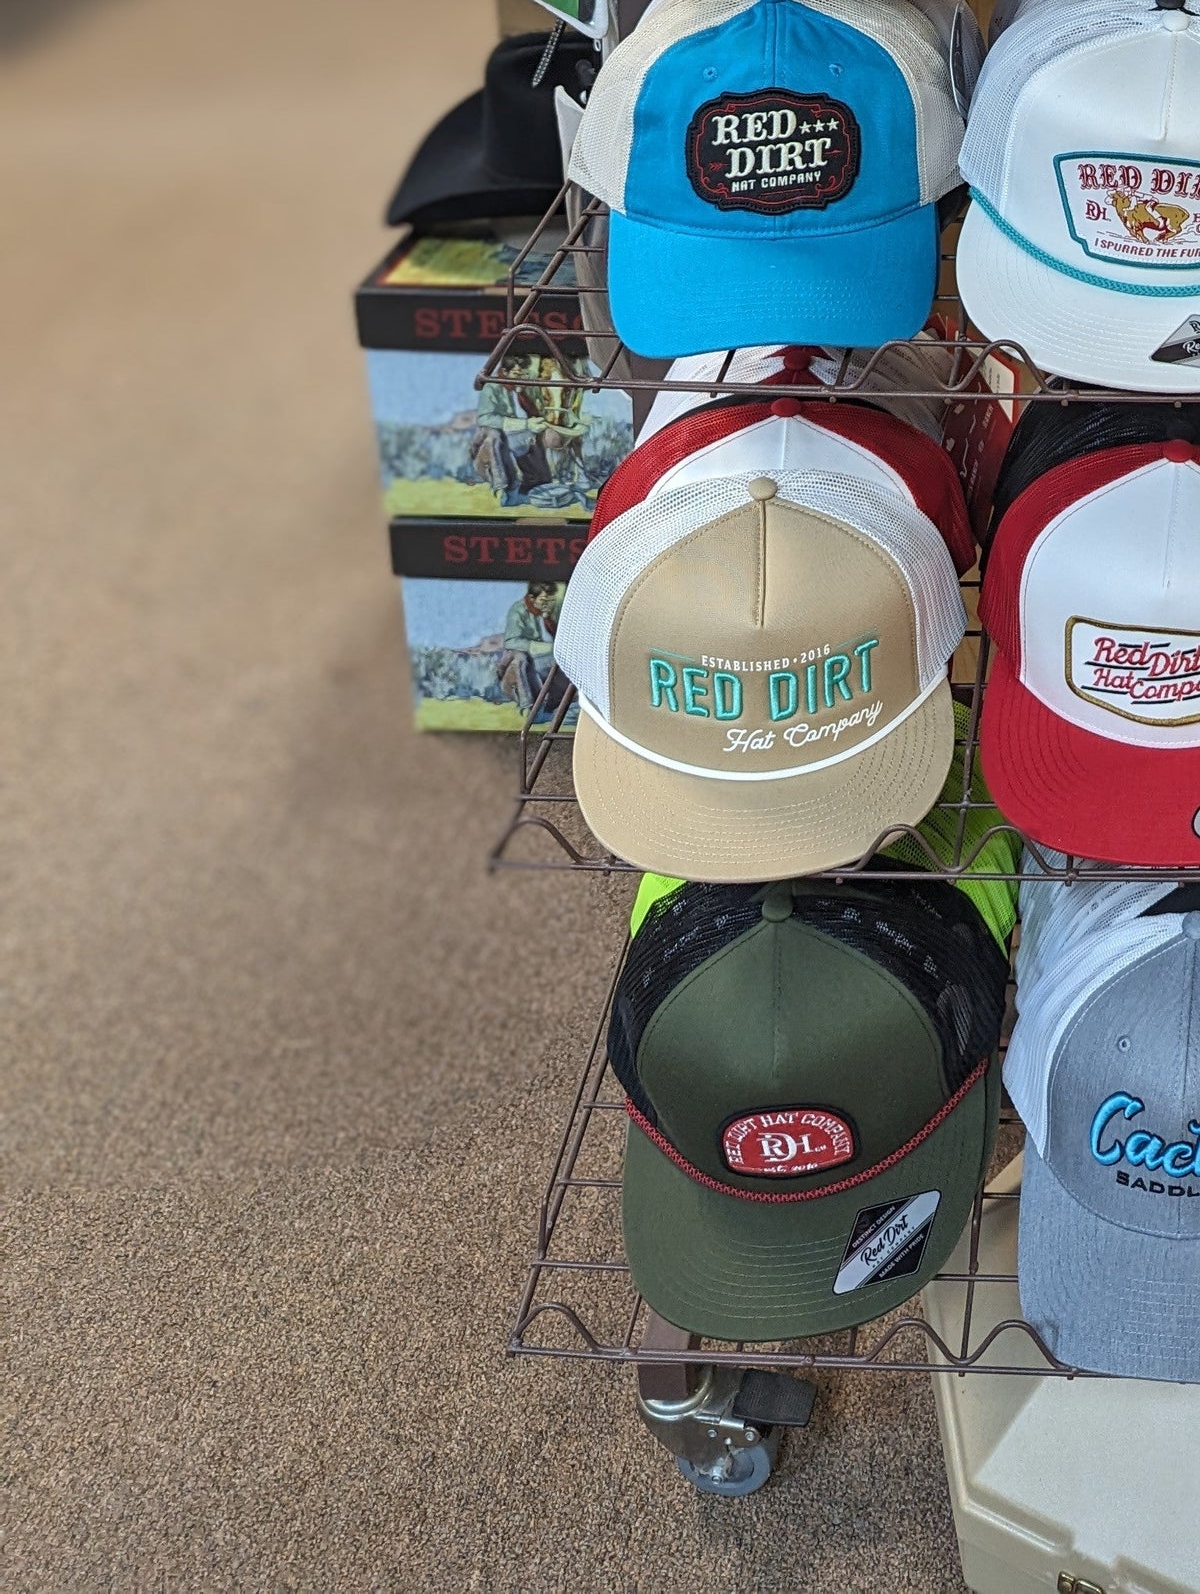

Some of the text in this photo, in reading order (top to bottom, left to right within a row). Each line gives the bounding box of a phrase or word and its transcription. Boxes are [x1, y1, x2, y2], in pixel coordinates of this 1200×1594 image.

[711, 109, 797, 146] RED
[724, 138, 833, 179] DIRT
[731, 170, 822, 193] HAT COMPANY
[1077, 164, 1143, 191] RED
[1100, 239, 1154, 257] SPURRED
[1156, 247, 1179, 258] THE
[701, 644, 831, 671] ESTABLISHED 2016
[1094, 637, 1151, 666] Red
[650, 639, 880, 722] RED DIRT
[1093, 668, 1136, 690] Hat
[723, 700, 884, 753] Hat Company
[760, 1111, 799, 1128] HAT
[801, 1113, 850, 1156] COMPANY
[860, 1214, 908, 1266] Red Dirt
[879, 1261, 896, 1278] MADE
[908, 1234, 924, 1249] PRIDE
